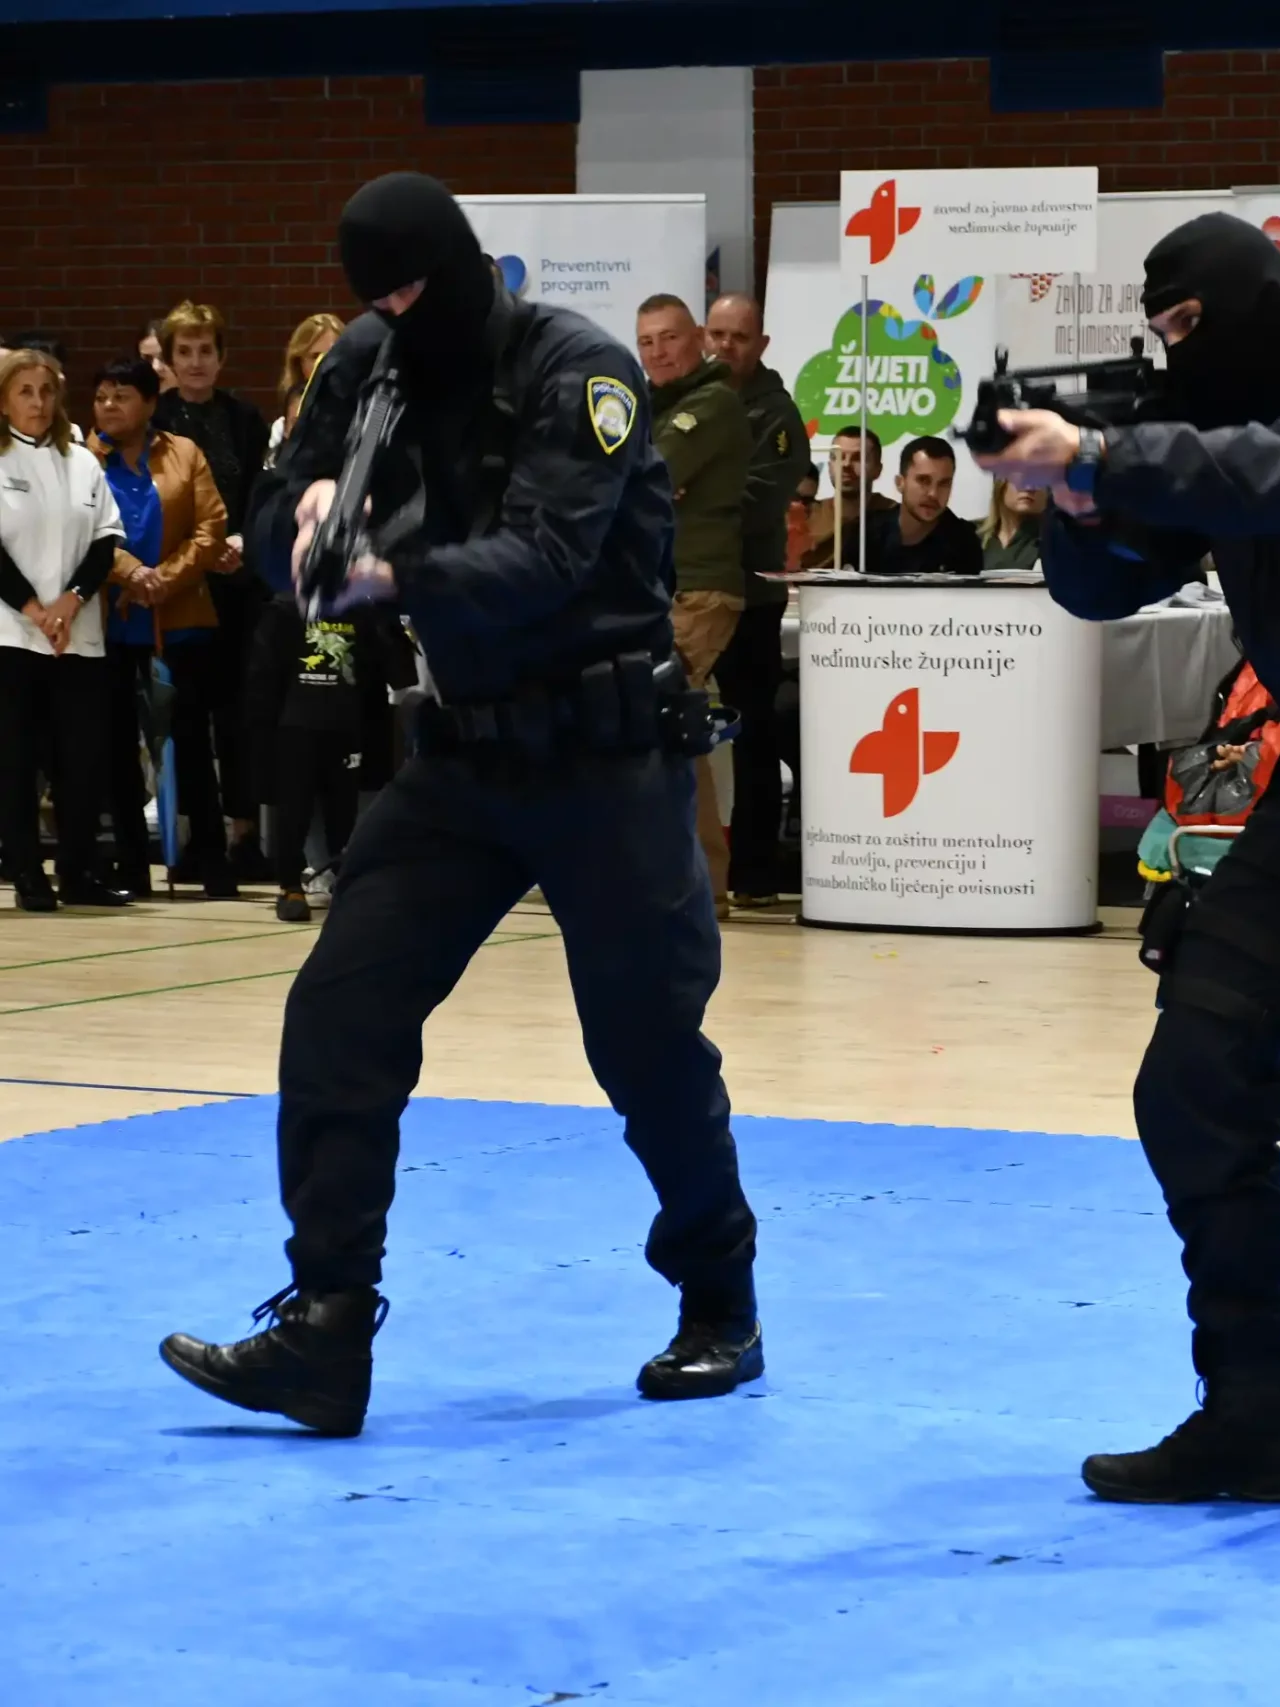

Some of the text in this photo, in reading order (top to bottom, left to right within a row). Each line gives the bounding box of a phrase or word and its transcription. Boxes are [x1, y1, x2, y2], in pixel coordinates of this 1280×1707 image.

[933, 200, 1092, 218] zavod za javno zdravstvo
[541, 258, 631, 273] Preventivni
[541, 279, 610, 295] program
[1099, 284, 1113, 314] ZA
[1118, 284, 1146, 314] JAV
[1055, 325, 1133, 354] MEIMURSKE
[836, 339, 929, 383] ŽIVJETI
[822, 387, 937, 416] ZDRAVO
[841, 622, 861, 636] za
[864, 616, 923, 643] javno
[930, 617, 1042, 637] zdravstvo
[918, 650, 1015, 677] županije
[865, 836, 882, 845] za
[885, 831, 937, 847] zaštitu
[942, 833, 1034, 854] mentalnog
[831, 850, 986, 875] zdravlja, prevenciju i
[890, 877, 954, 899] liječenje
[958, 879, 1034, 894] ovisnosti
